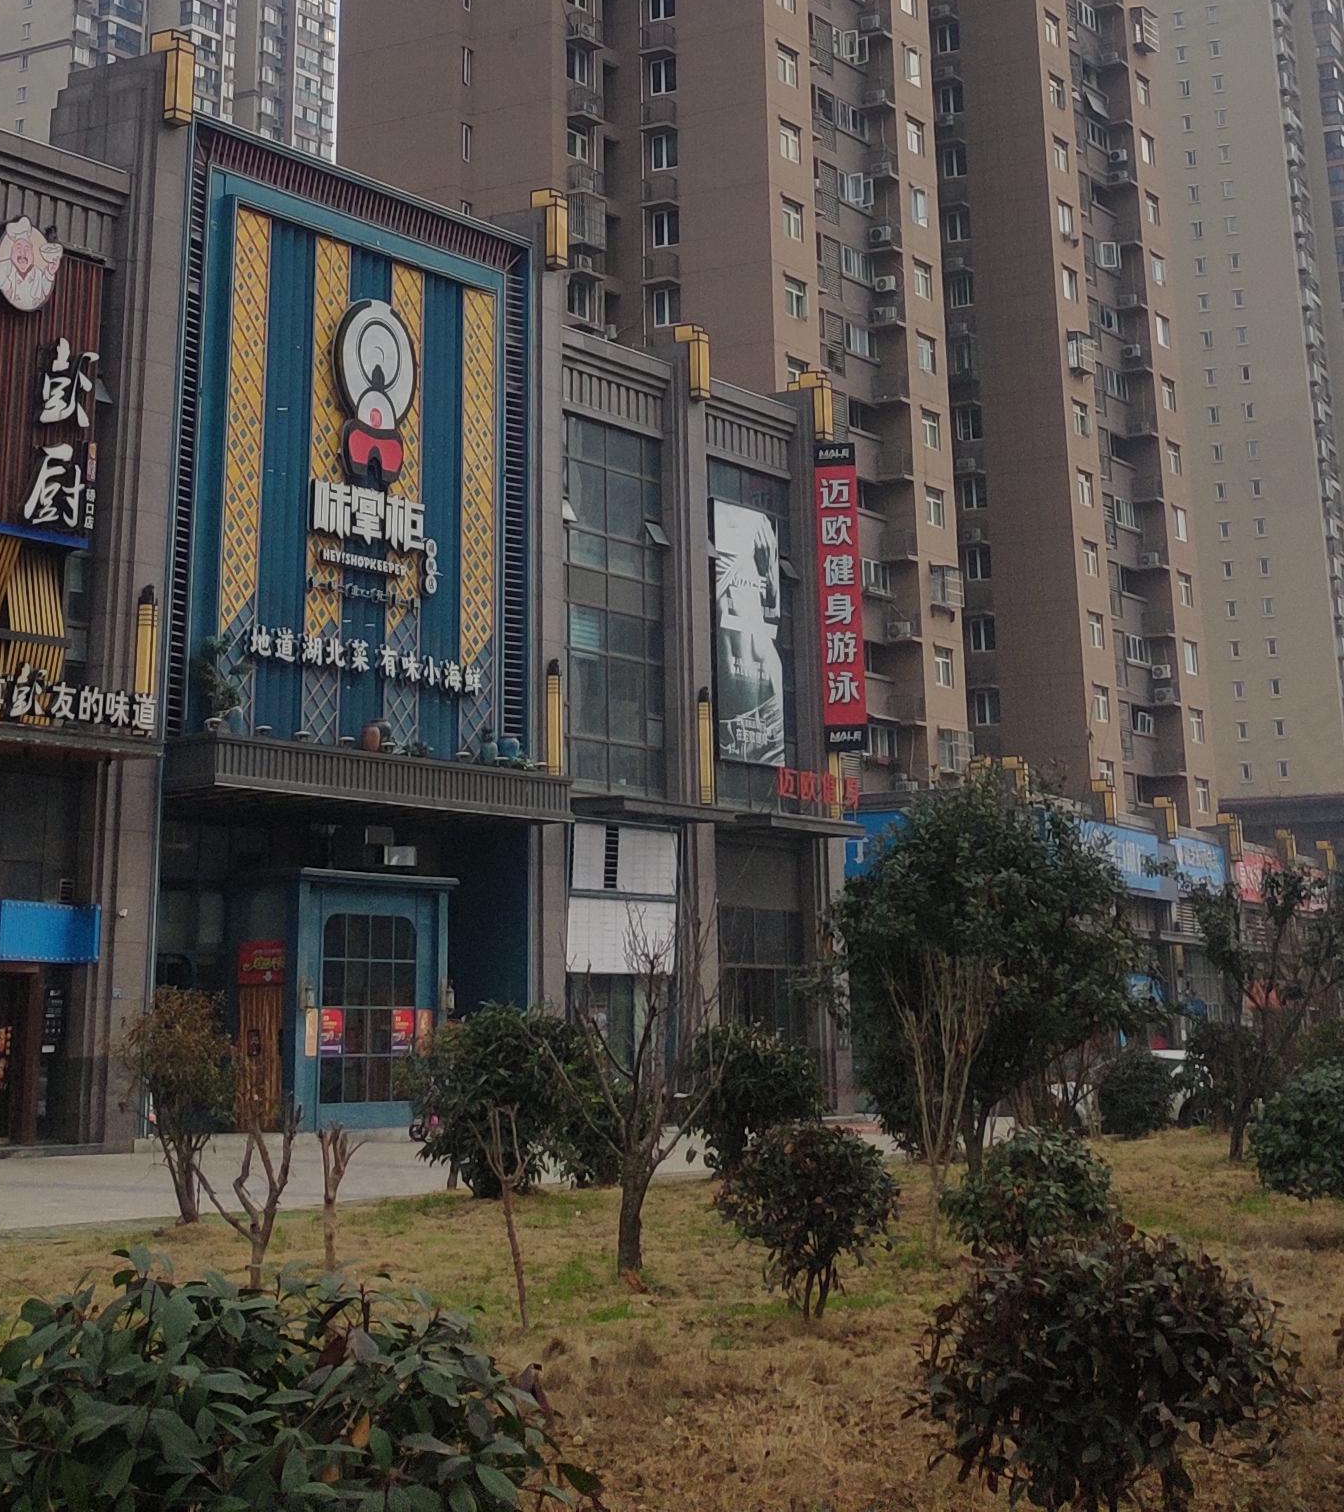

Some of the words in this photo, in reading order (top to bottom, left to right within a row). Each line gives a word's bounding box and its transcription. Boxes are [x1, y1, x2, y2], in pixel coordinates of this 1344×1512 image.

[24, 337, 100, 528] 彭厨
[313, 478, 425, 552] 味掌柜
[819, 478, 860, 705] 迈欧健身游泳
[250, 624, 371, 673] 地道湖北菜
[380, 644, 482, 697] 有味小海鲜
[778, 766, 860, 809] 迈欧健身
